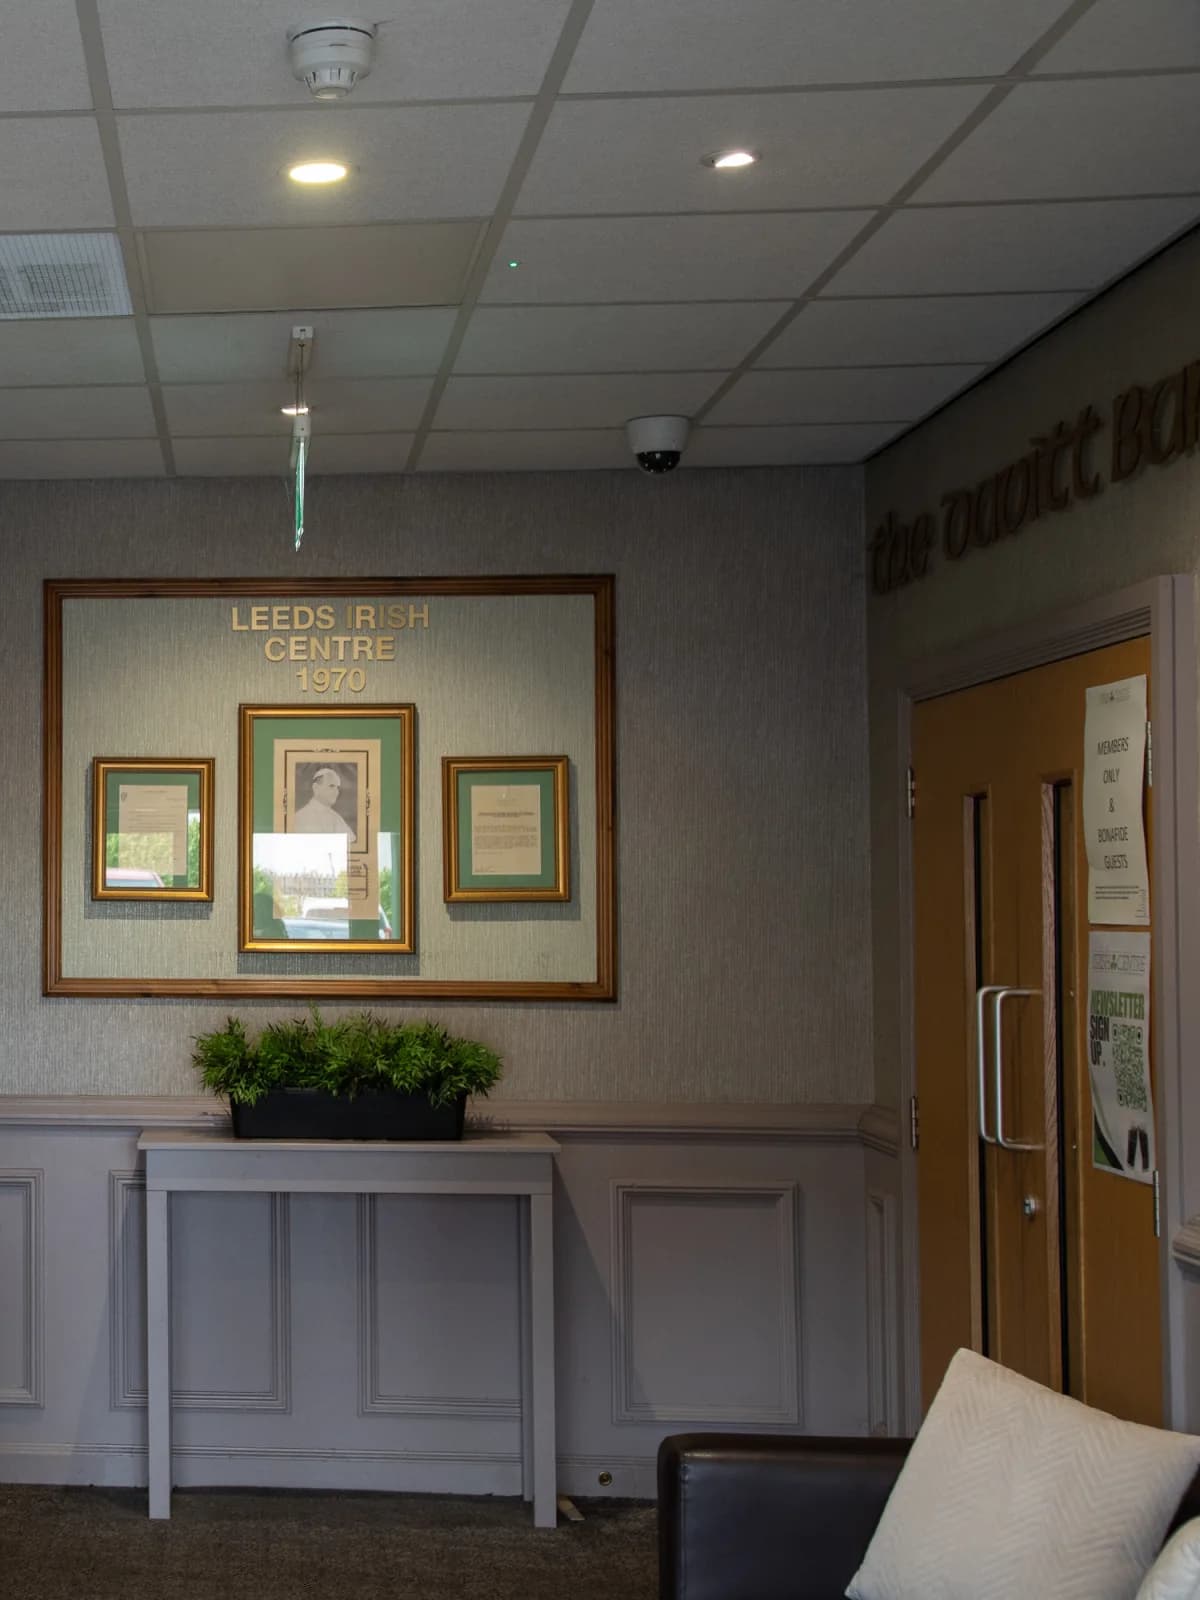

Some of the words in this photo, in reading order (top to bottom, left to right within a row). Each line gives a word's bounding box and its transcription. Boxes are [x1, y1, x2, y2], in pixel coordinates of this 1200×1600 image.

[231, 604, 336, 631] LEEDS
[346, 603, 430, 630] IRISH
[264, 635, 397, 662] CENTRE
[296, 666, 367, 693] 1970
[1097, 737, 1129, 755] MEMBERS
[1103, 769, 1120, 784] ONLY
[1108, 798, 1115, 813] &
[1098, 826, 1129, 843] BONAFIDE
[1103, 854, 1129, 870] GUESTS
[1091, 990, 1145, 1020] NEWSLETTER
[1089, 1015, 1109, 1041] SIGN
